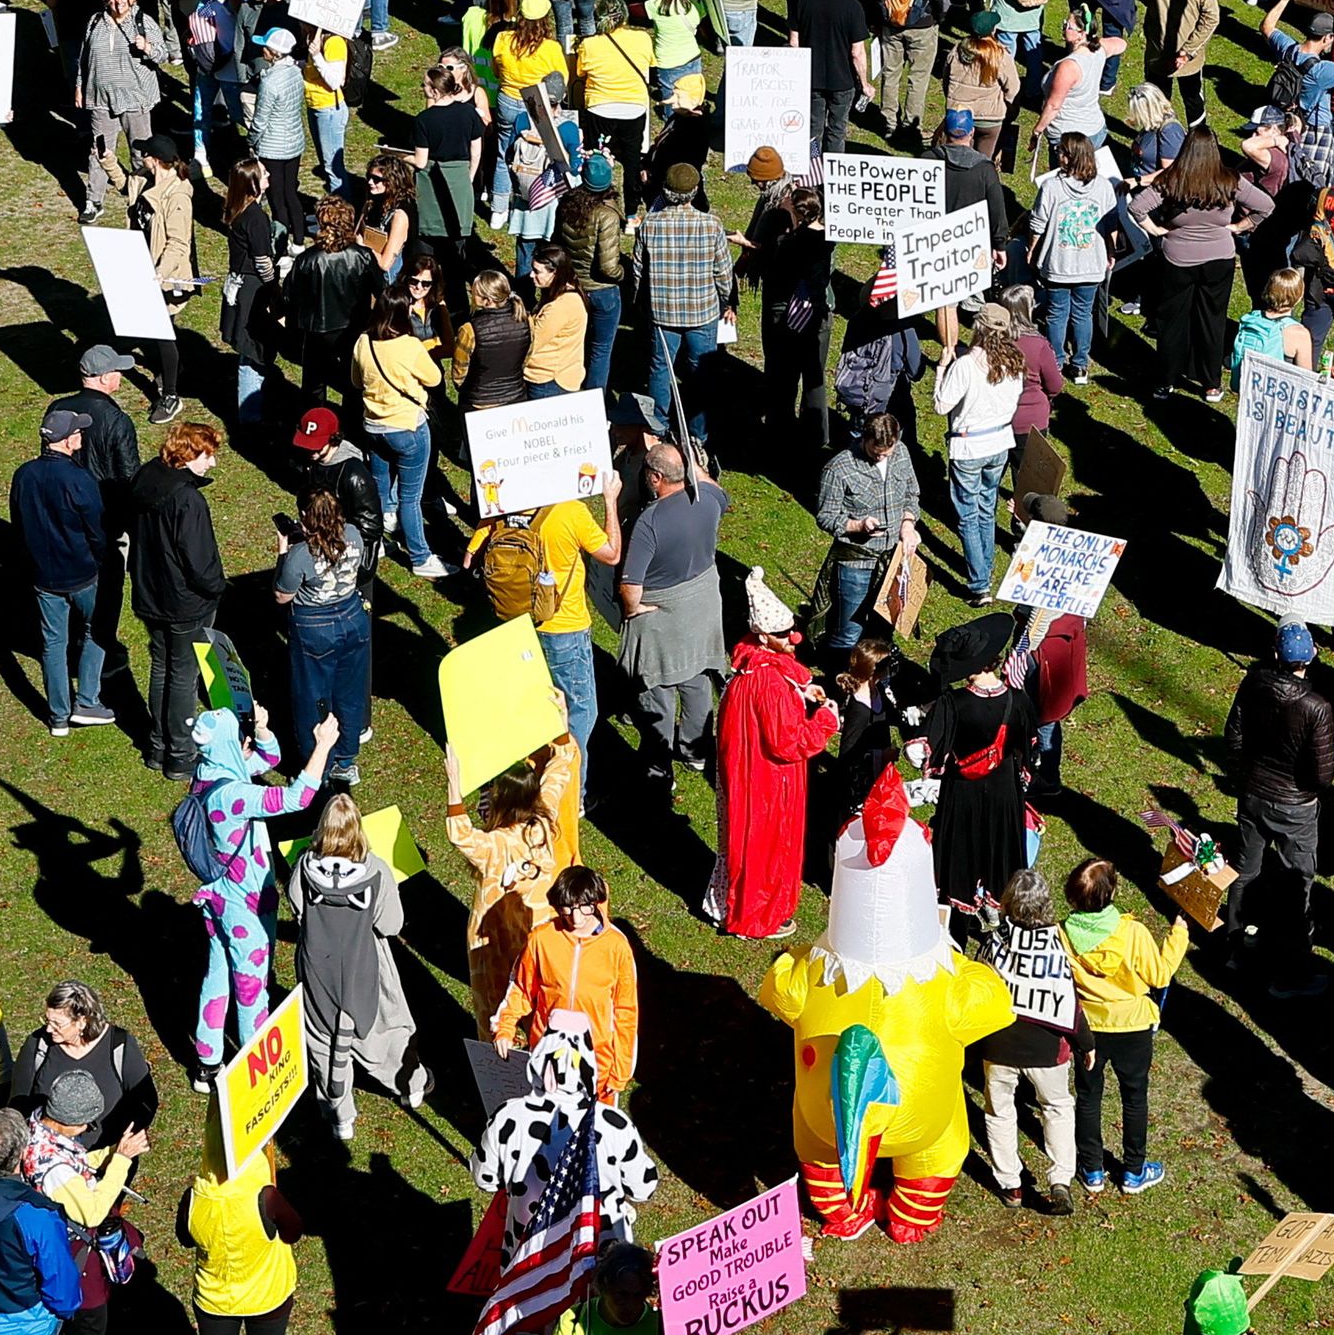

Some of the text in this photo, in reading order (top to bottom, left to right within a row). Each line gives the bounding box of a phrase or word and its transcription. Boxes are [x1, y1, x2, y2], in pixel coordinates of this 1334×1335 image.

[734, 60, 780, 78] TRAITOR
[827, 158, 921, 183] The Power
[827, 181, 938, 205] THE PEOPLE
[847, 201, 943, 221] Greater Than
[828, 223, 875, 242] People
[902, 210, 987, 257] Impeach
[907, 242, 983, 281] Traitor
[916, 271, 980, 310] Trump
[1246, 400, 1265, 424] IS
[485, 426, 508, 441] Give
[523, 435, 557, 451] NOBEL
[1035, 543, 1110, 575] MONARCHS
[1011, 583, 1095, 618] BUTTERFLIES
[246, 1026, 284, 1090] NO
[267, 1048, 293, 1086] KING
[245, 1064, 300, 1137] FASCISTS!!!
[666, 1191, 786, 1268] SPEAK OUT
[1275, 1220, 1319, 1241] GOP
[708, 1235, 750, 1268] Make
[672, 1233, 795, 1305] GOOD TROUBLE
[706, 1284, 747, 1310] Raise
